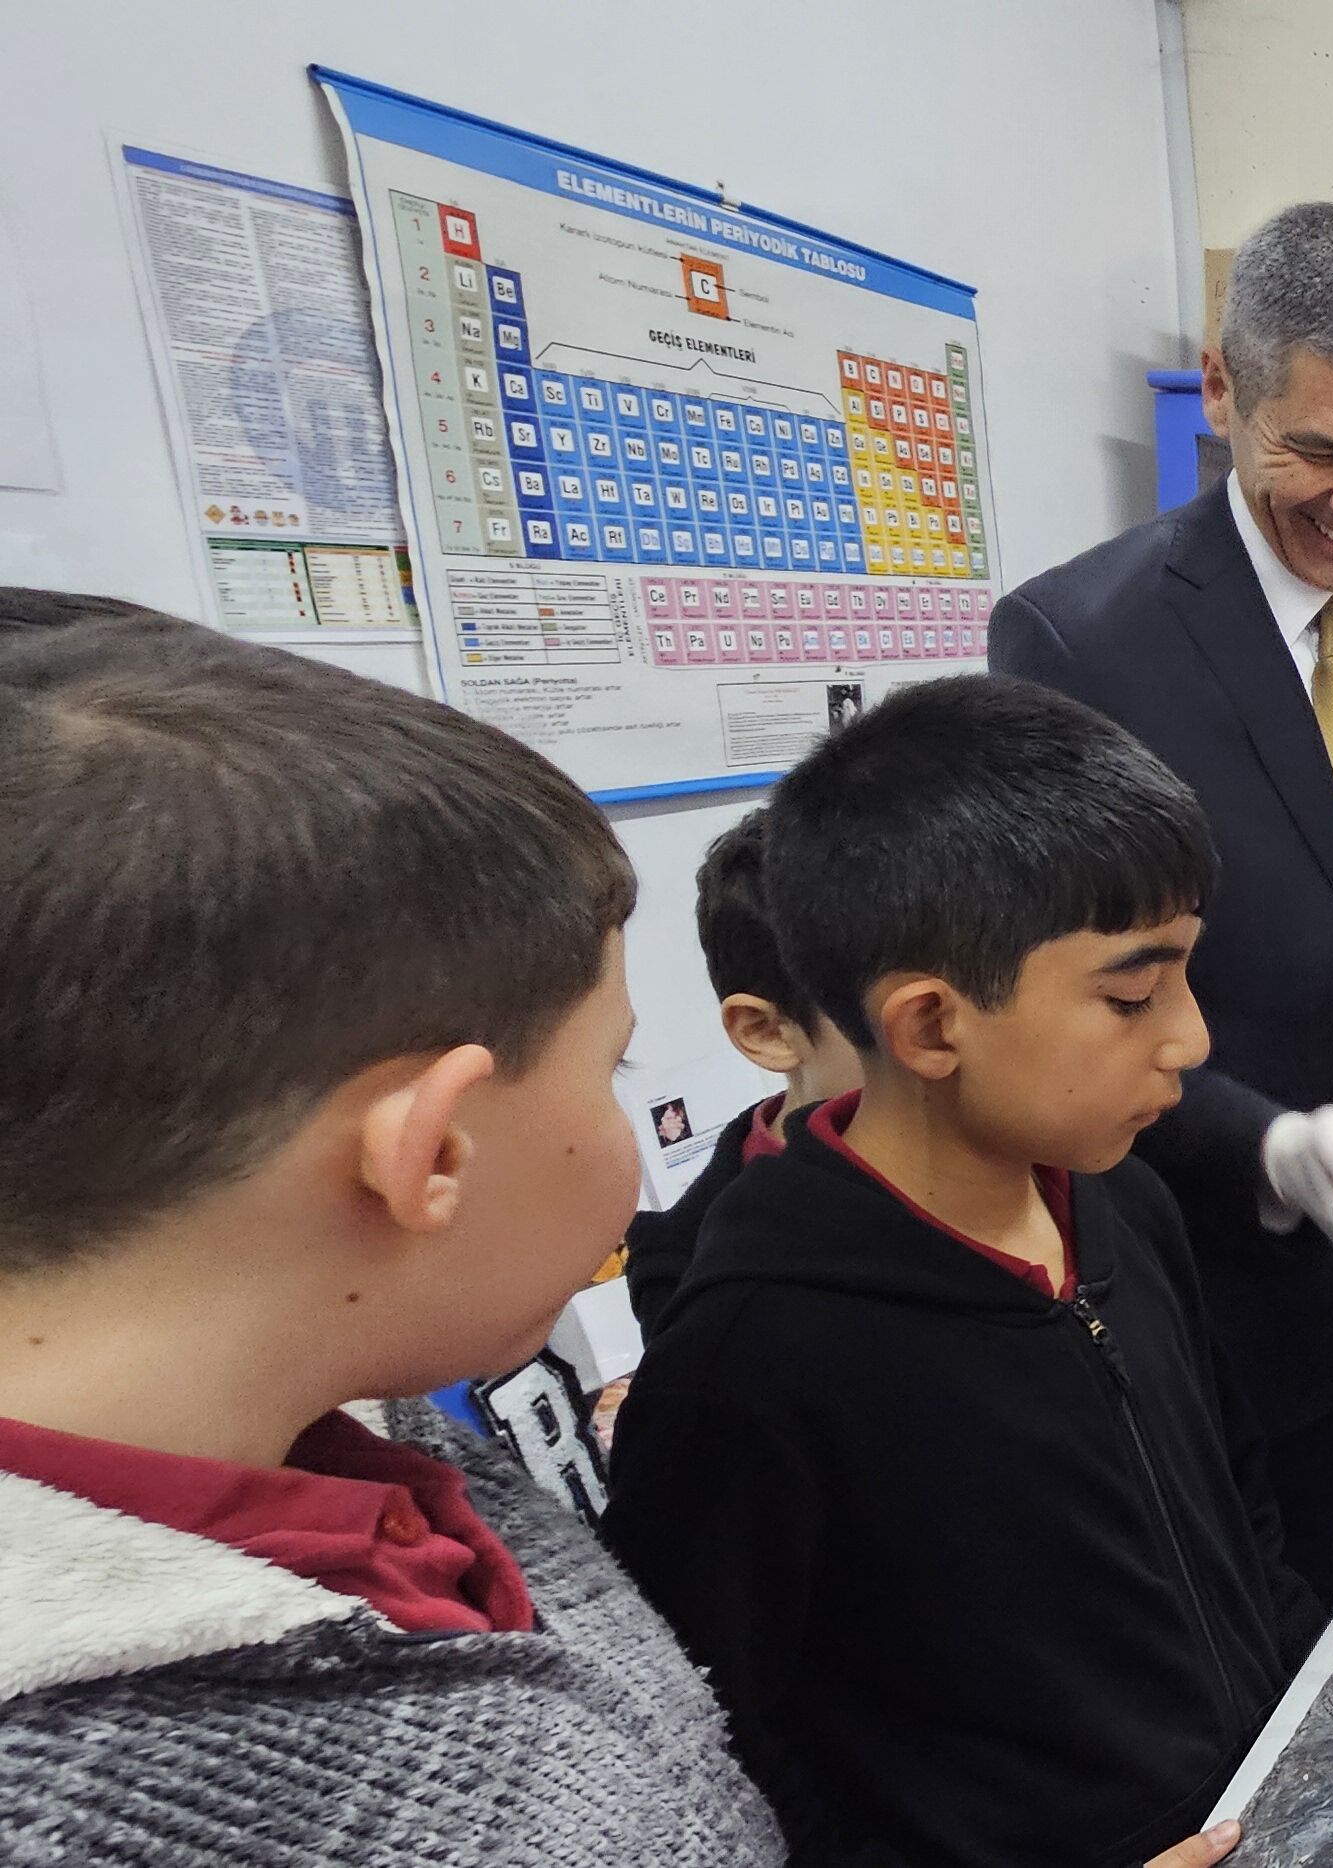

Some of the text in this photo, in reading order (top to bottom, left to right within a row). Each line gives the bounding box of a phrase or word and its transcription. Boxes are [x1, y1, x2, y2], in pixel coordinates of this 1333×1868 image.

[454, 224, 464, 239] H
[556, 170, 708, 232] ELEMENTLERİN
[711, 218, 800, 261] PERİYODİK
[801, 247, 866, 282] TABLOSU
[419, 266, 430, 281] 2
[459, 274, 473, 288] Li
[496, 282, 514, 298] Be
[701, 279, 710, 295] C
[424, 319, 436, 333] 3
[461, 322, 480, 339] Na
[503, 330, 519, 347] Mg
[649, 329, 756, 364] GEÇİŞ ELEMENTLERİ
[431, 371, 442, 384] 4
[472, 374, 481, 387] K
[510, 380, 525, 395] Ca
[546, 386, 563, 401] Sc
[585, 393, 598, 407] Ti
[624, 400, 633, 412] V
[656, 405, 670, 419] Cr
[719, 414, 733, 428] Fe
[749, 419, 762, 433] Co
[438, 419, 448, 433] 5
[474, 422, 494, 437] Rb
[518, 428, 530, 442] Sr
[558, 433, 567, 446] Y
[594, 438, 606, 452] Zr
[628, 442, 645, 456] Nb
[661, 447, 678, 461] Mo
[694, 451, 708, 465] Tc
[446, 470, 456, 483] 6
[482, 472, 500, 486] Cs
[526, 477, 540, 491] Ba
[562, 480, 578, 494] La
[634, 488, 650, 502] Ta
[670, 491, 682, 504] W
[702, 494, 714, 508] Re
[453, 520, 463, 534] 7
[492, 522, 507, 537] Fr
[532, 527, 549, 540] Ra
[570, 528, 588, 542] Ac
[650, 589, 665, 602] Ce
[684, 591, 696, 602] Pr
[714, 592, 729, 604] Nd
[656, 634, 672, 648] Th
[690, 634, 704, 647] Pa
[724, 635, 732, 647] U
